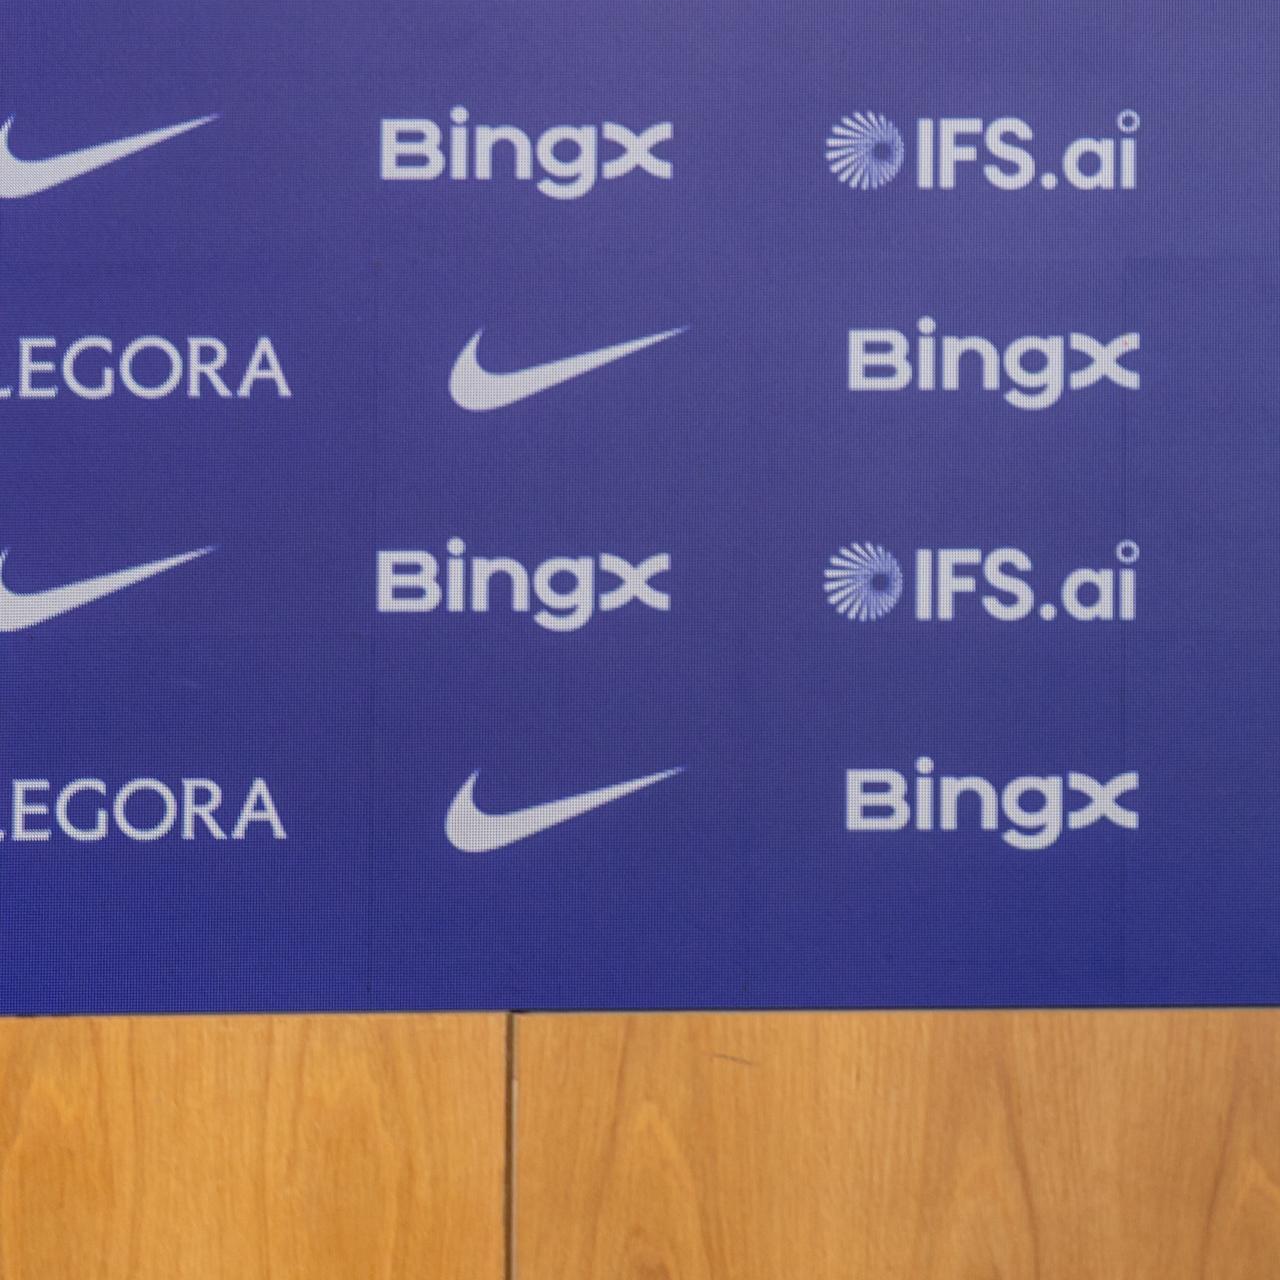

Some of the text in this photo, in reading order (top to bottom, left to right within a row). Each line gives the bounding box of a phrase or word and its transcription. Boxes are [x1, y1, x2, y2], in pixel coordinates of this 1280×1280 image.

[918, 111, 1139, 189] IFS.ai
[0, 336, 291, 399] EGORA
[916, 541, 1139, 620] IFS.ai
[0, 778, 286, 841] EGORA
